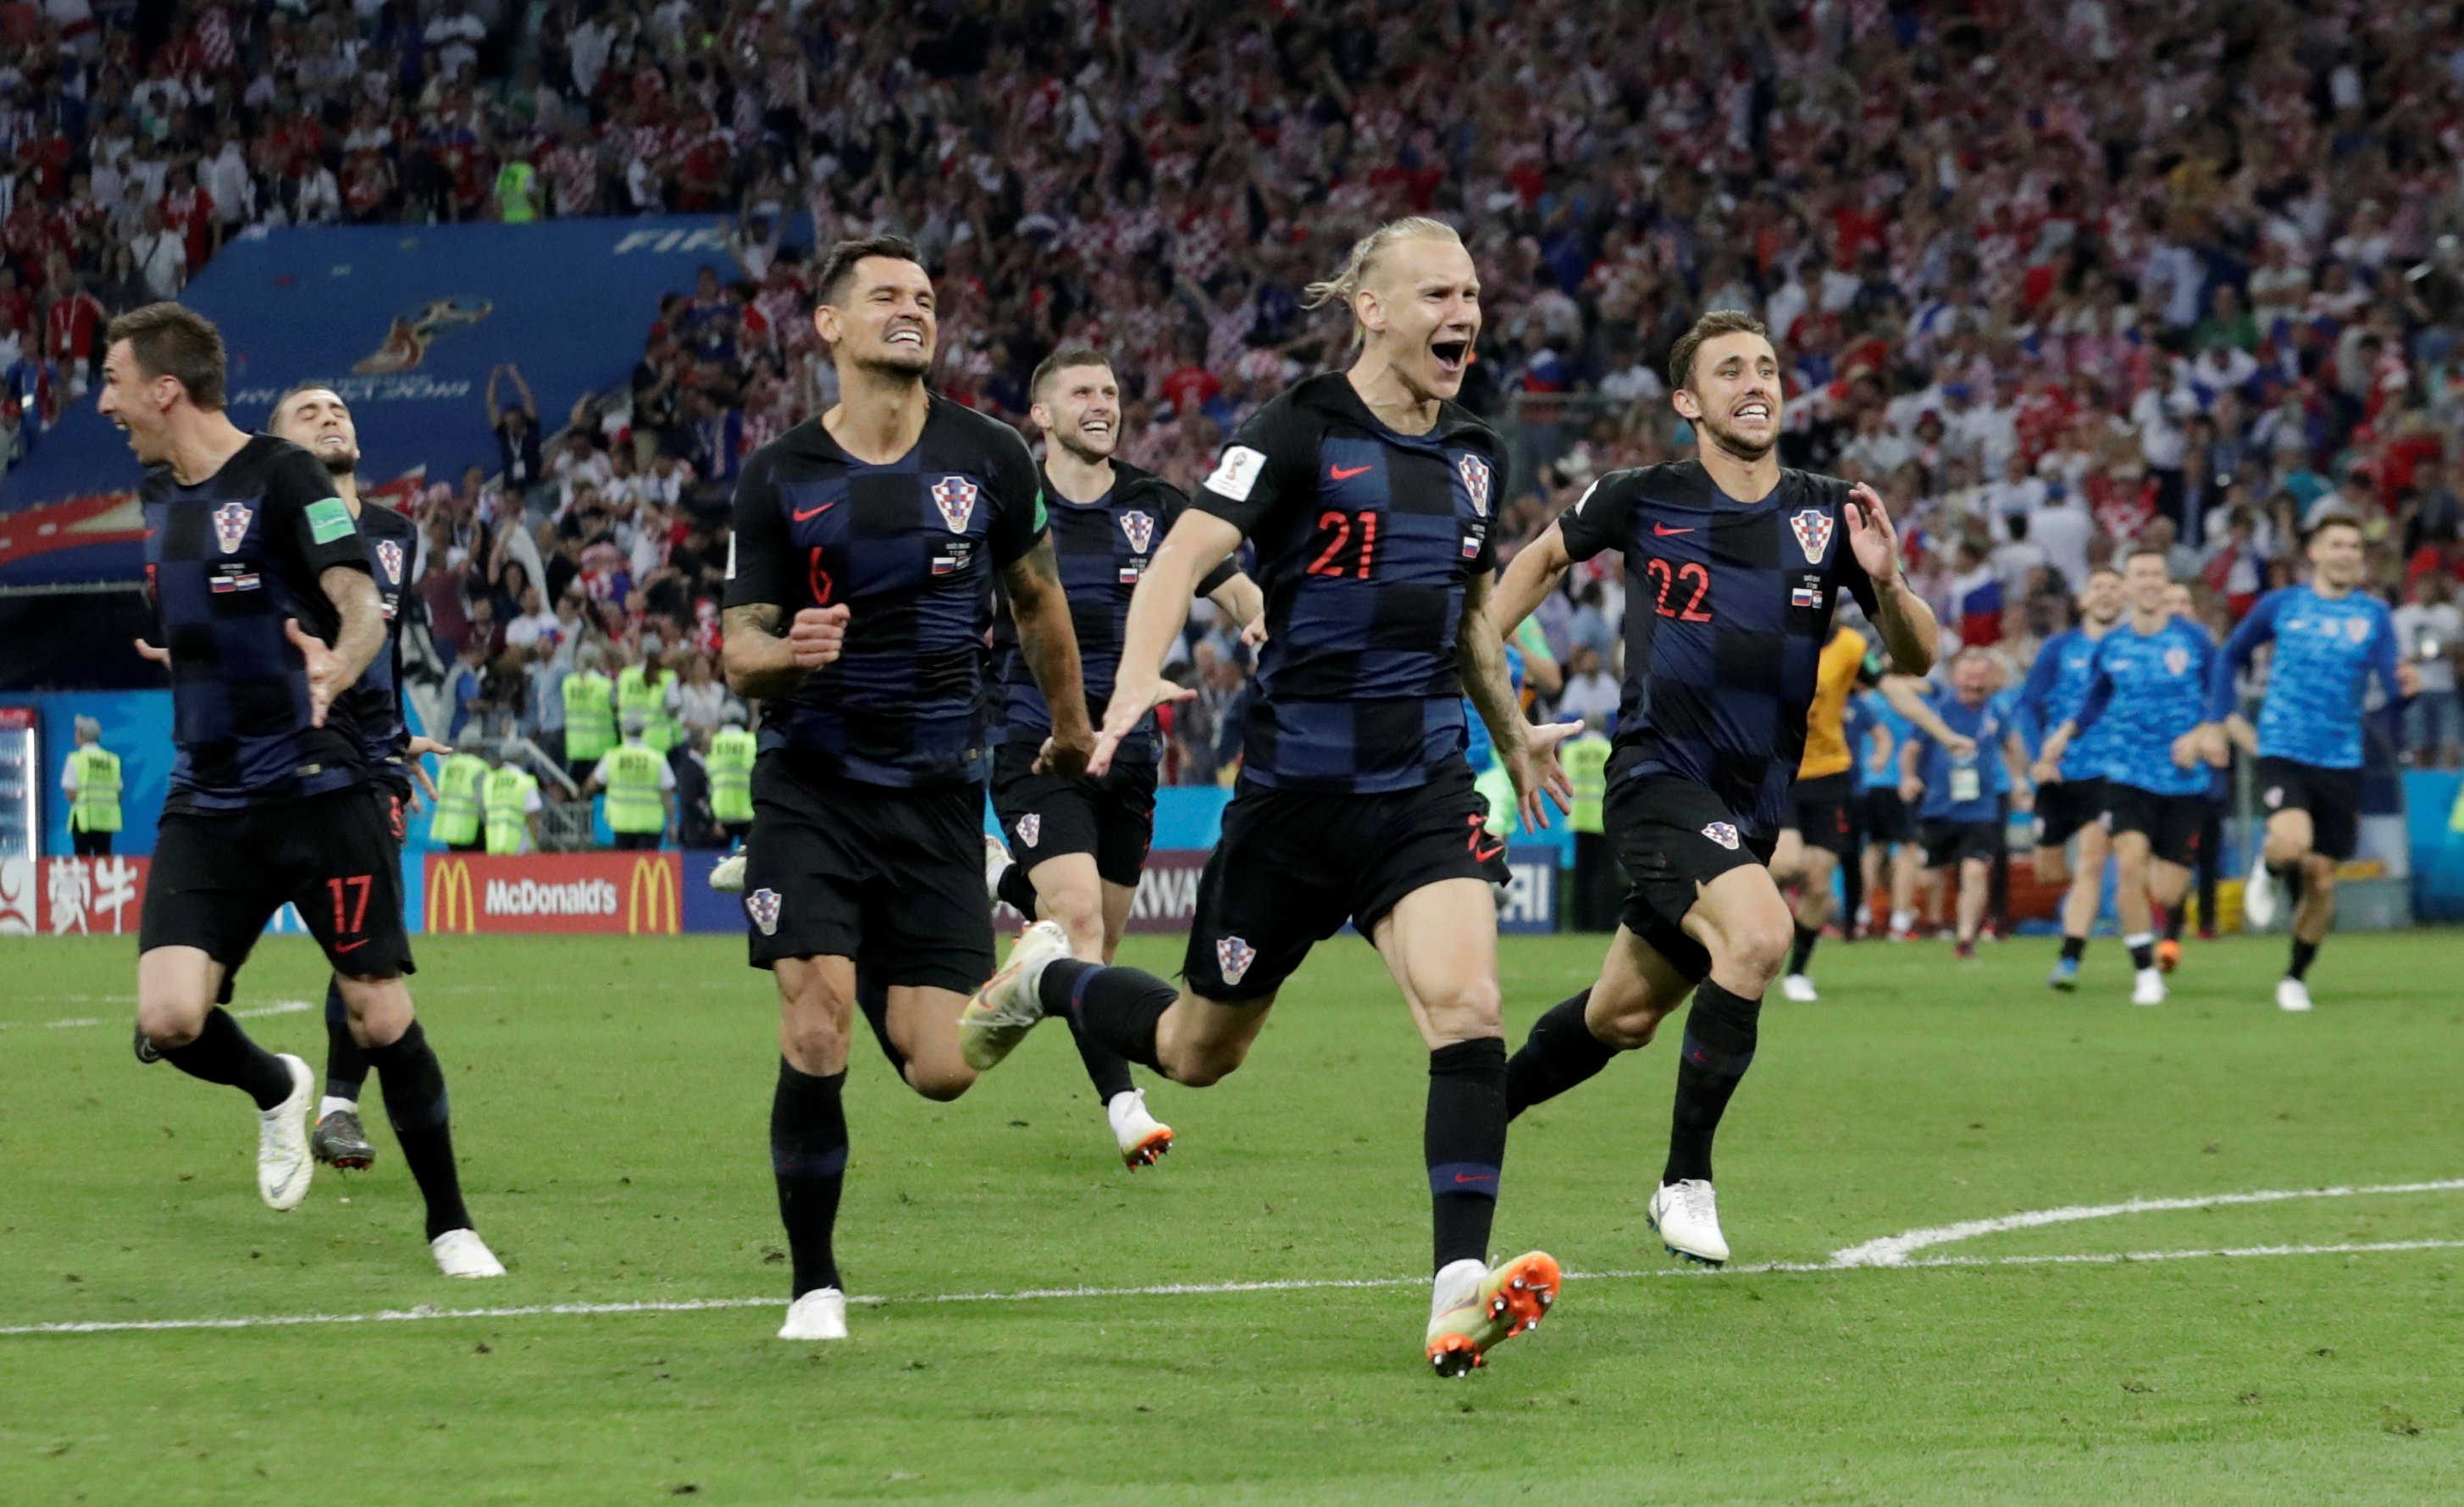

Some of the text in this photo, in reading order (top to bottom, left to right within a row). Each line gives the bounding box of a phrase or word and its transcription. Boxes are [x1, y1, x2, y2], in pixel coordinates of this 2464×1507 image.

[1306, 511, 1376, 579] 21
[808, 546, 833, 604] 6
[1647, 558, 1712, 623] 22
[326, 875, 373, 934] 17
[485, 878, 617, 916] McDonald's
